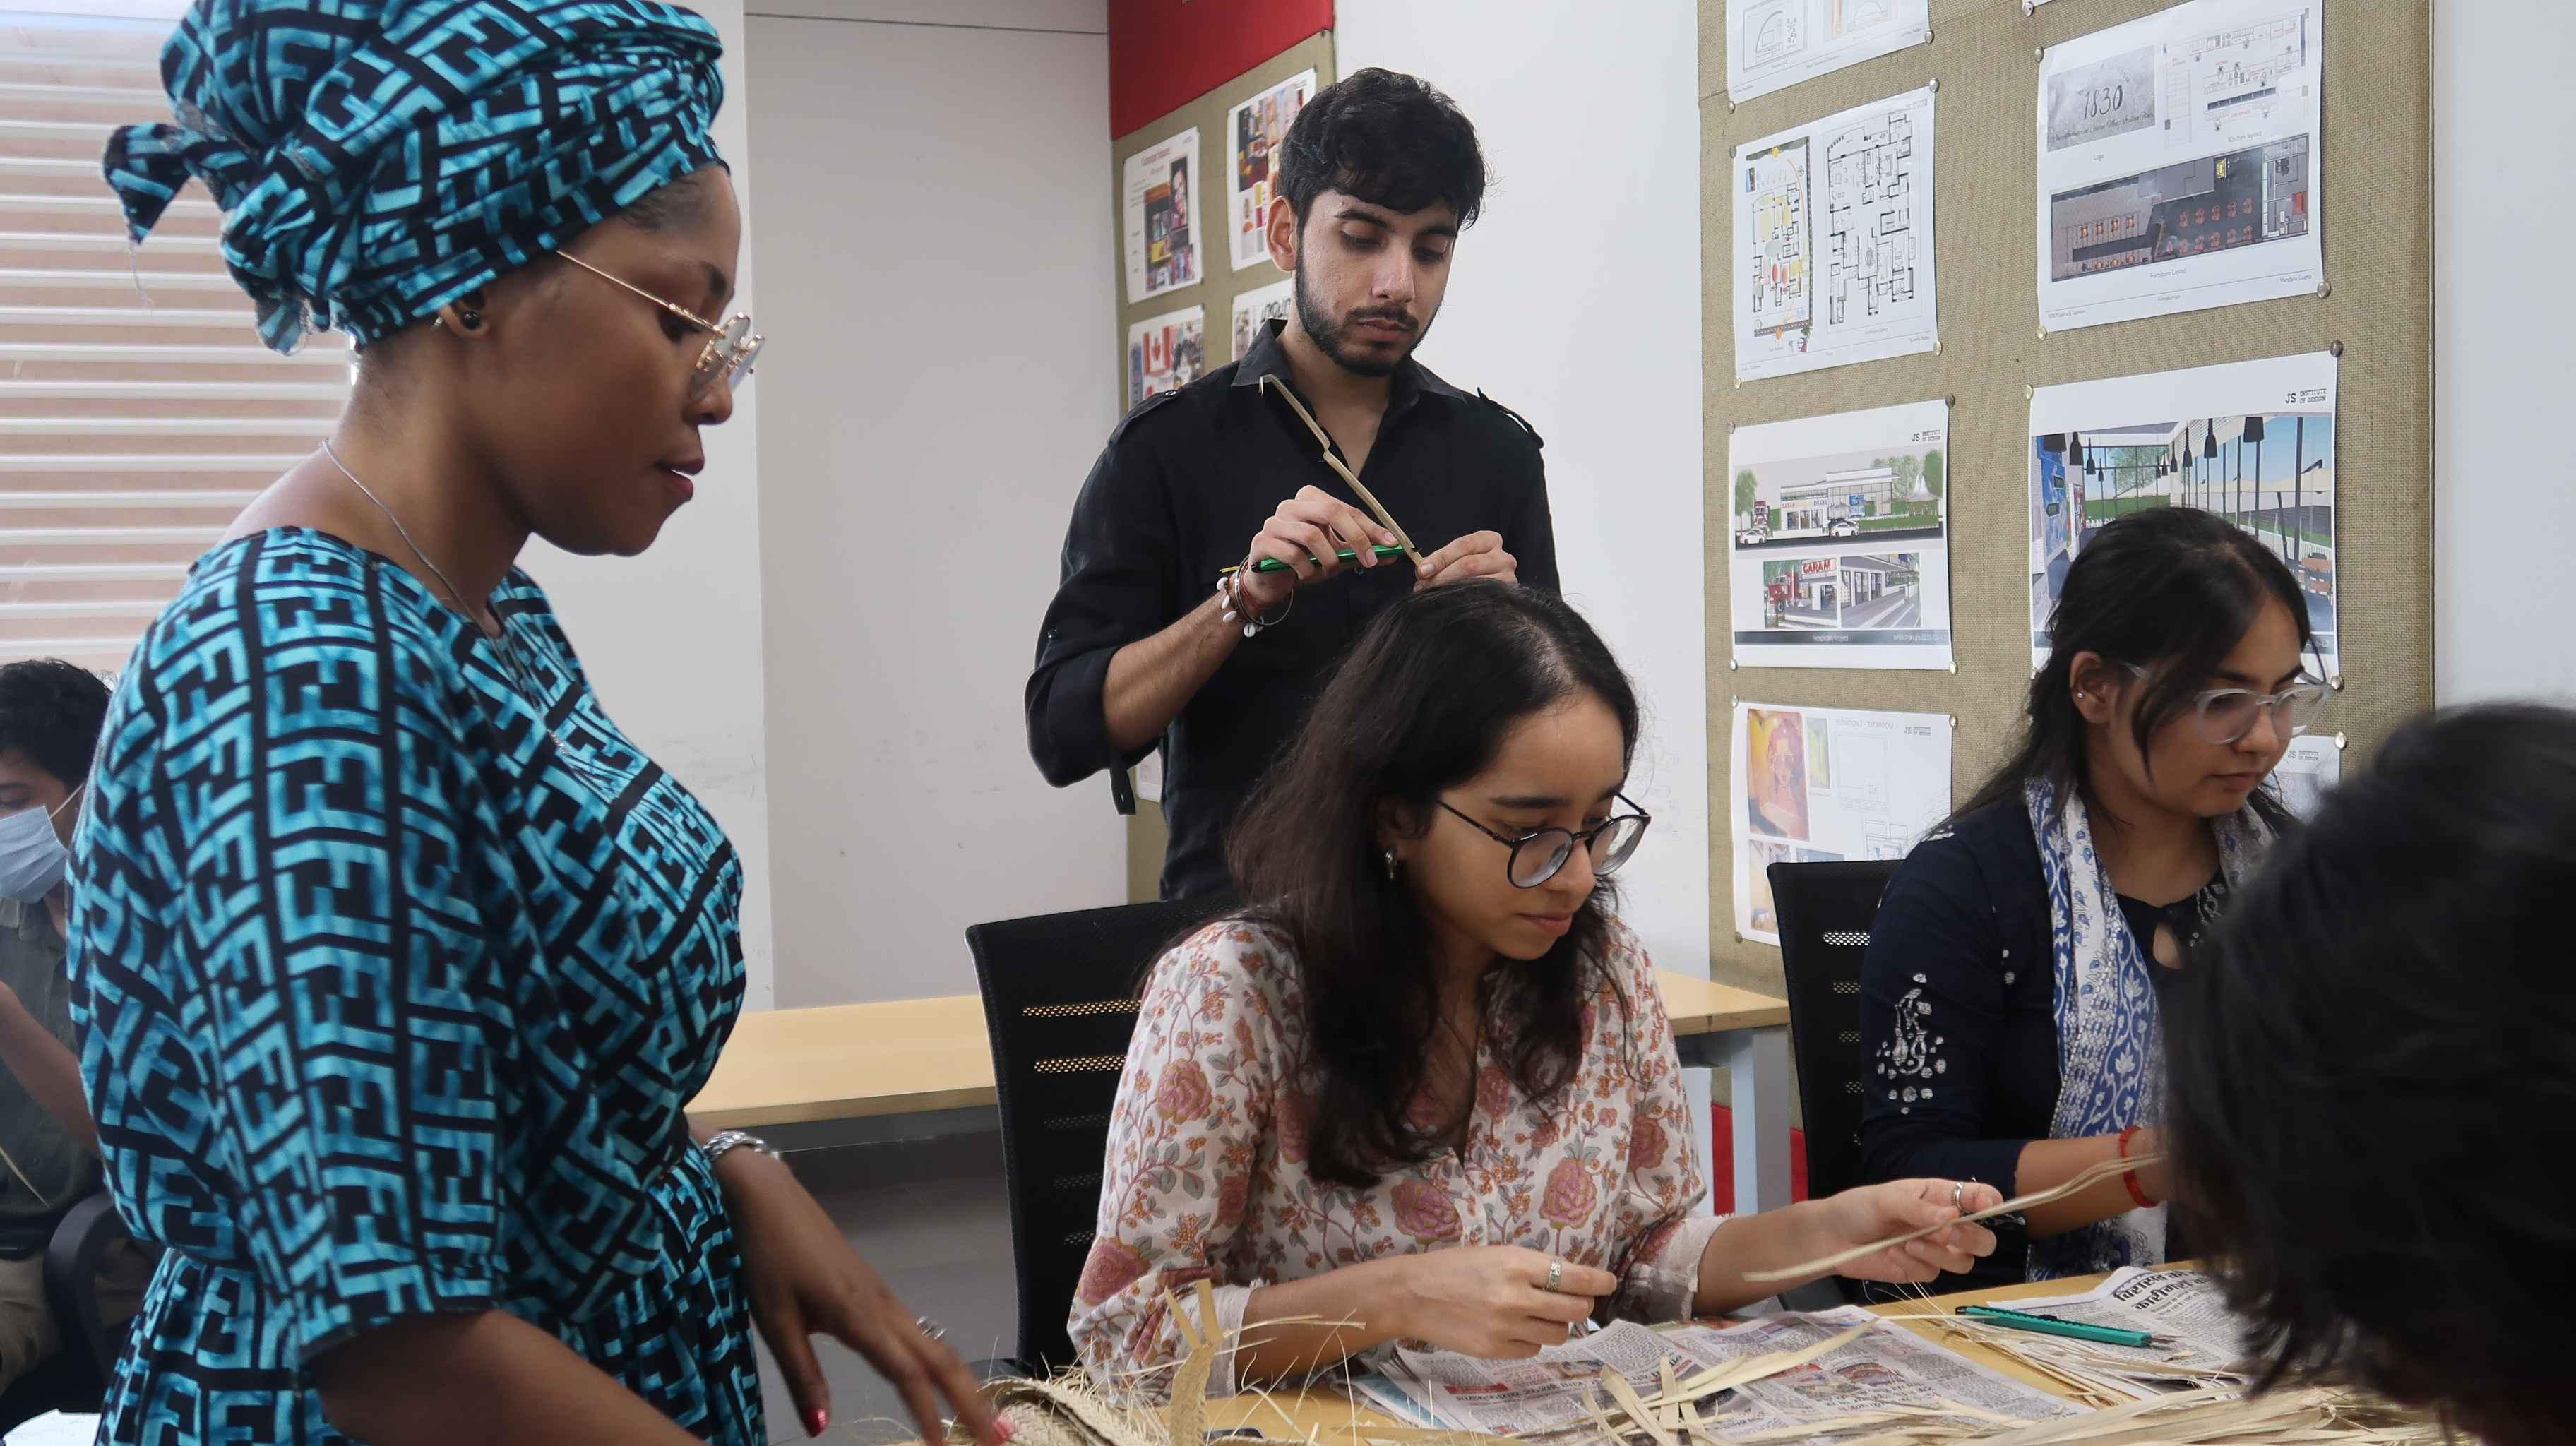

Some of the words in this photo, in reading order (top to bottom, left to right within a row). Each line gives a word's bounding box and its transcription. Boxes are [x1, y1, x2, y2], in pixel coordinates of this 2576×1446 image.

[2077, 85, 2123, 119] 1830
[2285, 393, 2297, 404] JS
[1912, 433, 1921, 442] JS
[1803, 559, 1831, 573] GARAM
